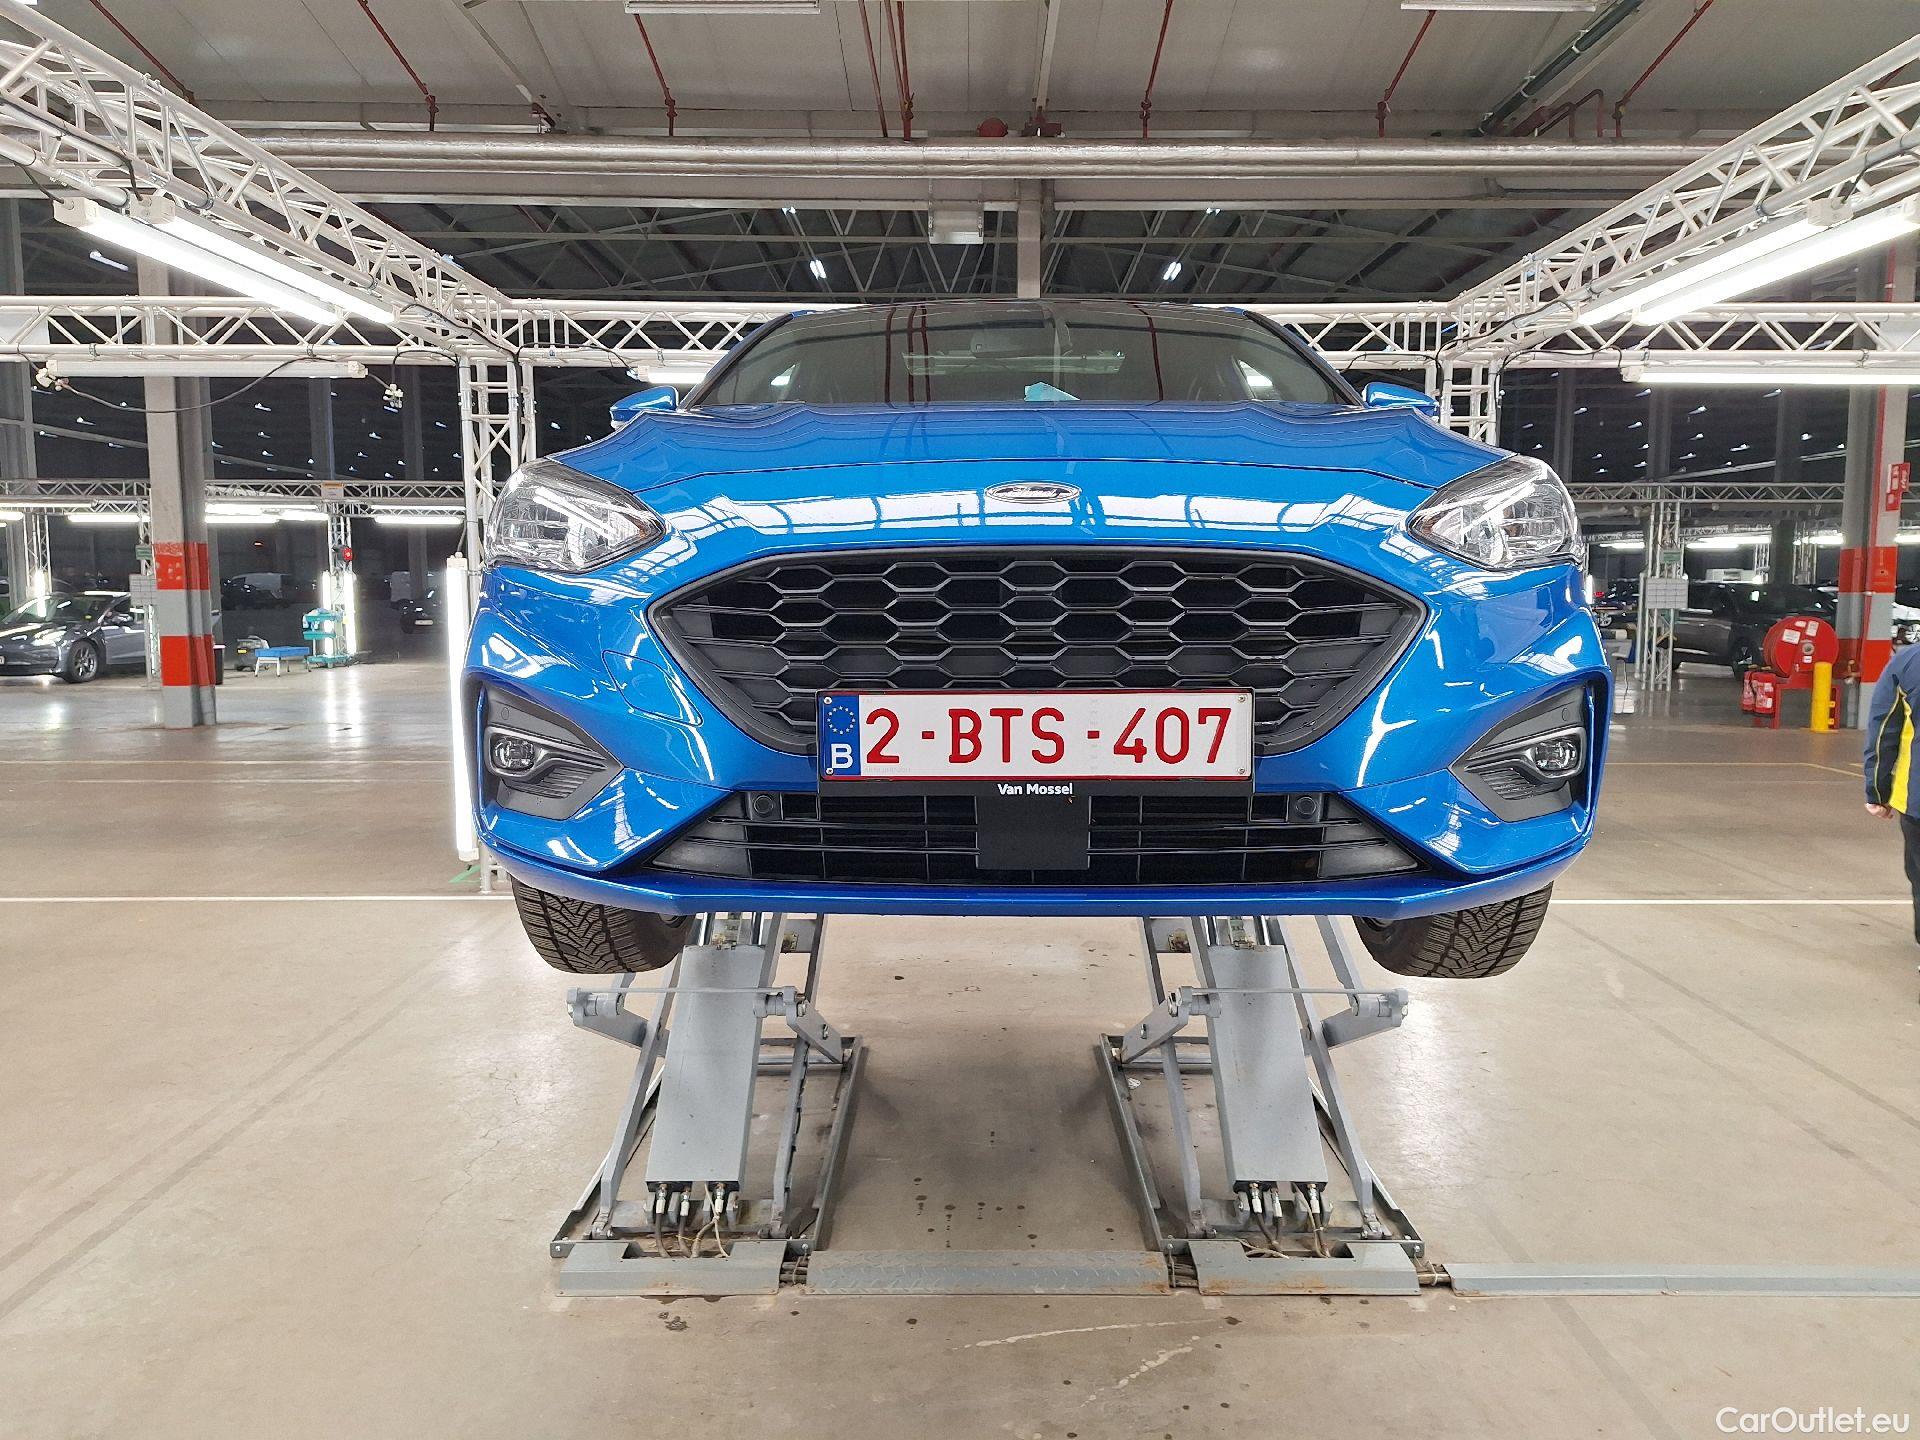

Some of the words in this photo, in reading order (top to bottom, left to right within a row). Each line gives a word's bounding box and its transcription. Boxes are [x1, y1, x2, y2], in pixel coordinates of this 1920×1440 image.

[866, 707, 1232, 764] 2-BTS-407
[830, 743, 853, 769] B
[998, 784, 1023, 795] Van
[1026, 783, 1073, 795] Mossel
